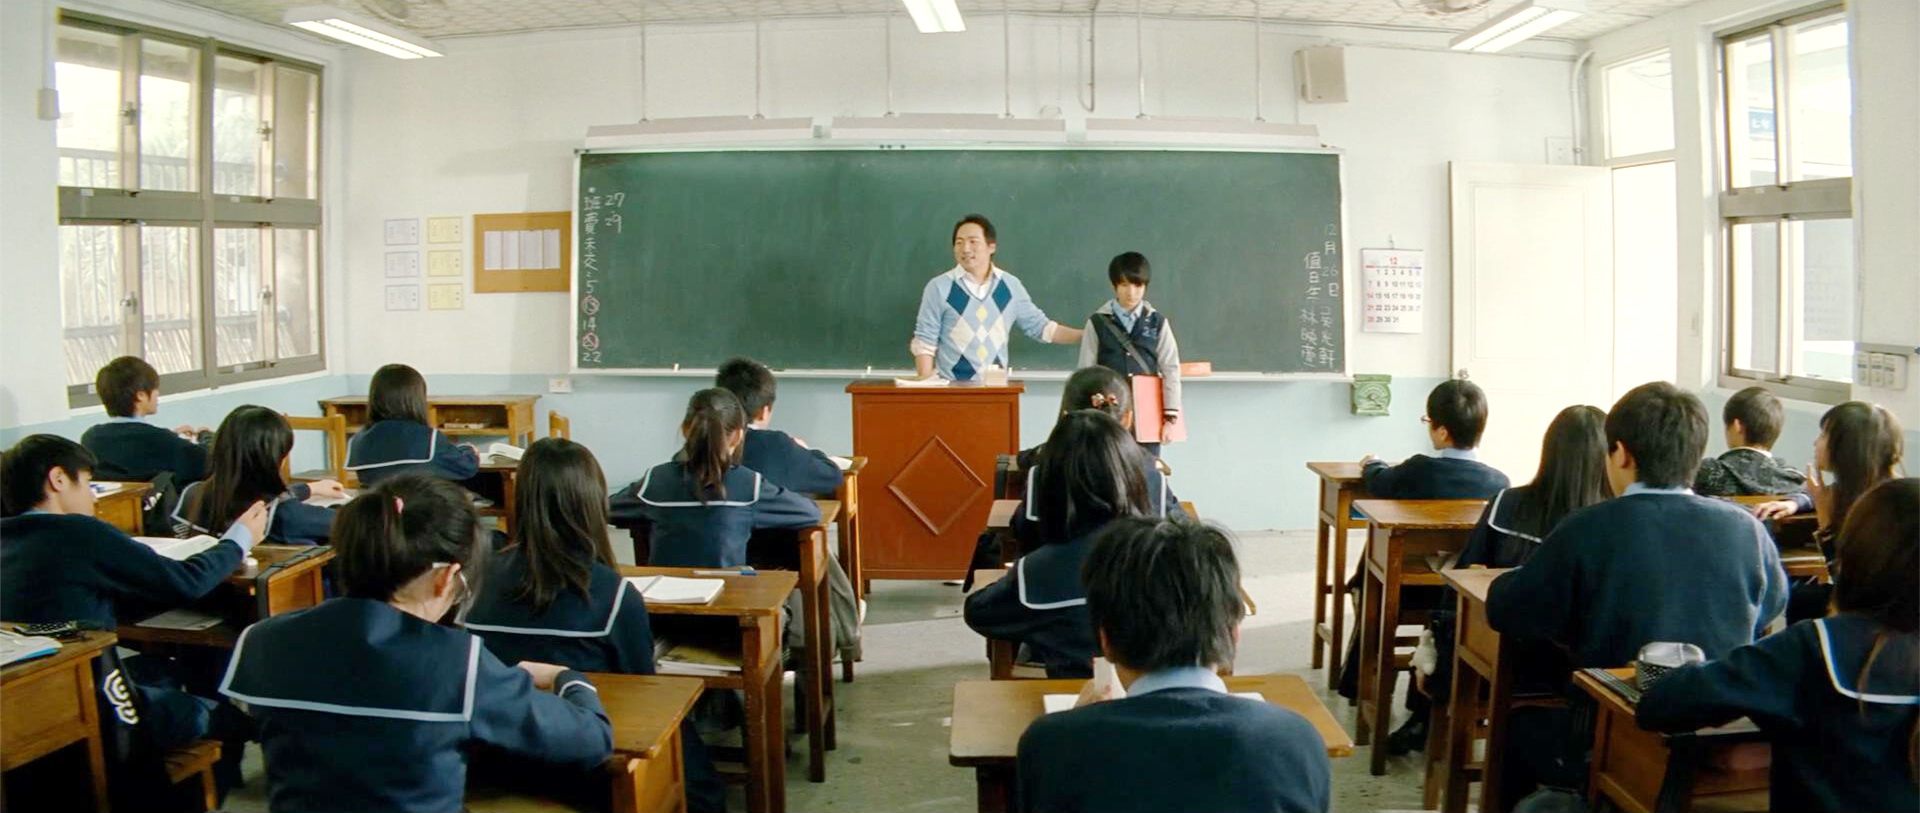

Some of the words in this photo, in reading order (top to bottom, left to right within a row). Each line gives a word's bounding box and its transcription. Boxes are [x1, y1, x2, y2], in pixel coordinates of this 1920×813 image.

[604, 191, 625, 208] 27
[1303, 251, 1321, 300] 值日生
[583, 316, 597, 331] 14
[583, 351, 602, 363] 22
